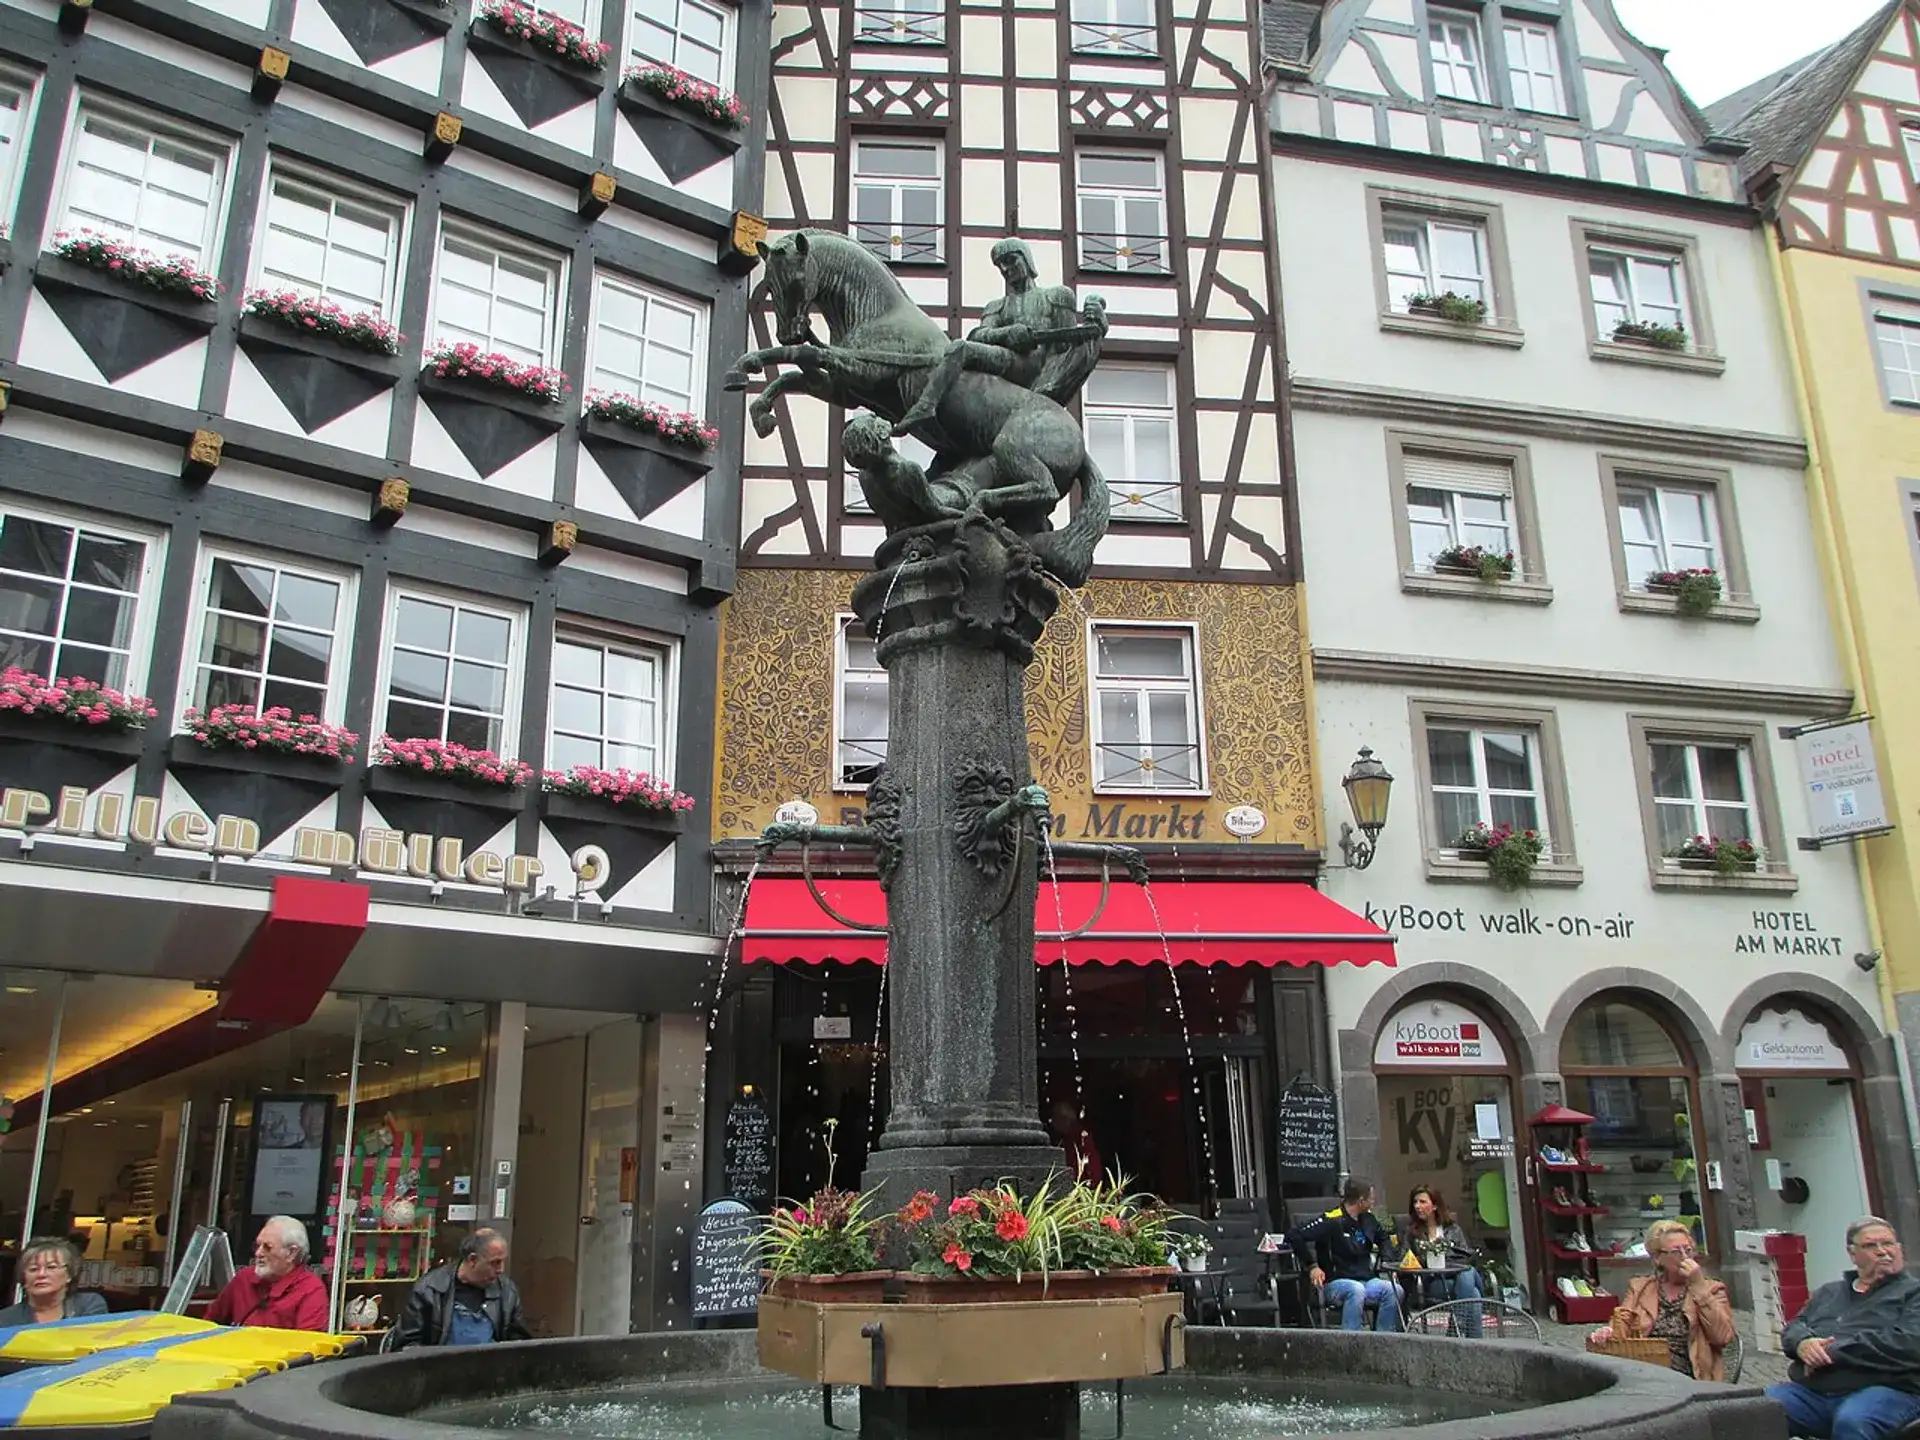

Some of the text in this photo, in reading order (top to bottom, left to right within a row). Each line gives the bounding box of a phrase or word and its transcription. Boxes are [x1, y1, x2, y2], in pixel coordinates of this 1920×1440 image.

[1080, 803, 1206, 839] Markt
[293, 826, 544, 889] müller
[1364, 901, 1635, 938] kyBoot walk-on-air
[1752, 910, 1817, 931] HOTEL
[1735, 934, 1842, 956] AM MARKT
[1395, 1021, 1460, 1043] kyBoot
[1399, 1044, 1458, 1053] walk-on-air
[1762, 1042, 1824, 1054] Geldautomat
[704, 1215, 745, 1229] Heute
